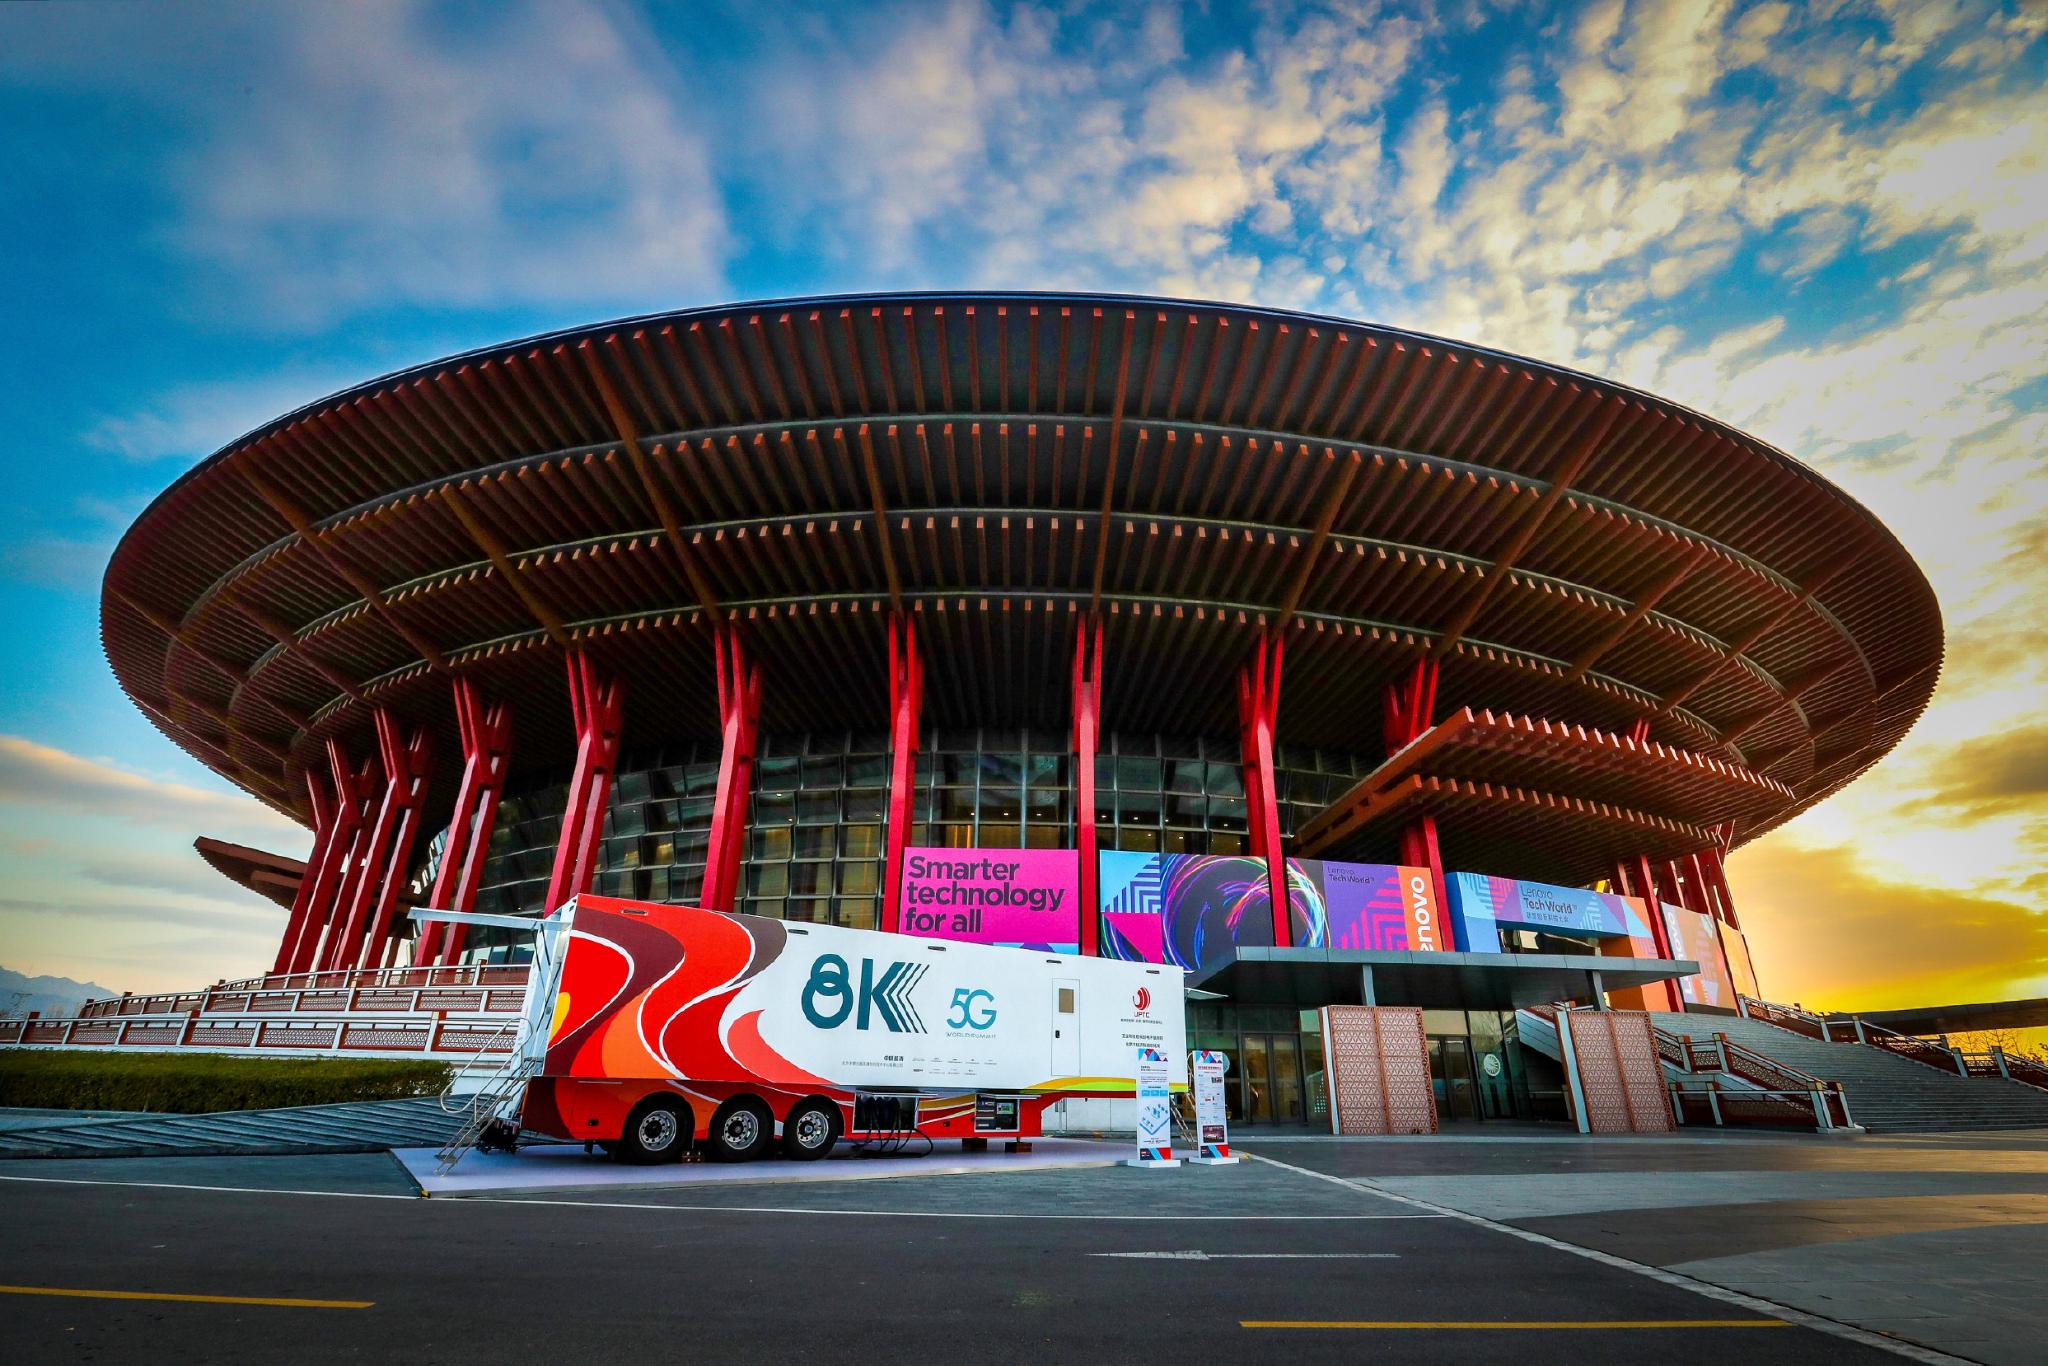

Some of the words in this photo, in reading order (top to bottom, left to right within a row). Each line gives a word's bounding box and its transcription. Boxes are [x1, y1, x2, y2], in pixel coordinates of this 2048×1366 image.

[908, 856, 1020, 880] Smarter
[1327, 866, 1354, 875] Lenovo
[1329, 874, 1346, 883] Tech
[1347, 875, 1371, 884] World
[907, 881, 1064, 911] technology
[1520, 885, 1553, 899] Lenovo
[1524, 897, 1546, 911] Tech
[1545, 899, 1573, 914] World
[905, 907, 946, 932] for
[951, 909, 982, 933] all
[801, 954, 930, 1034] 8K
[946, 988, 997, 1030] 5G
